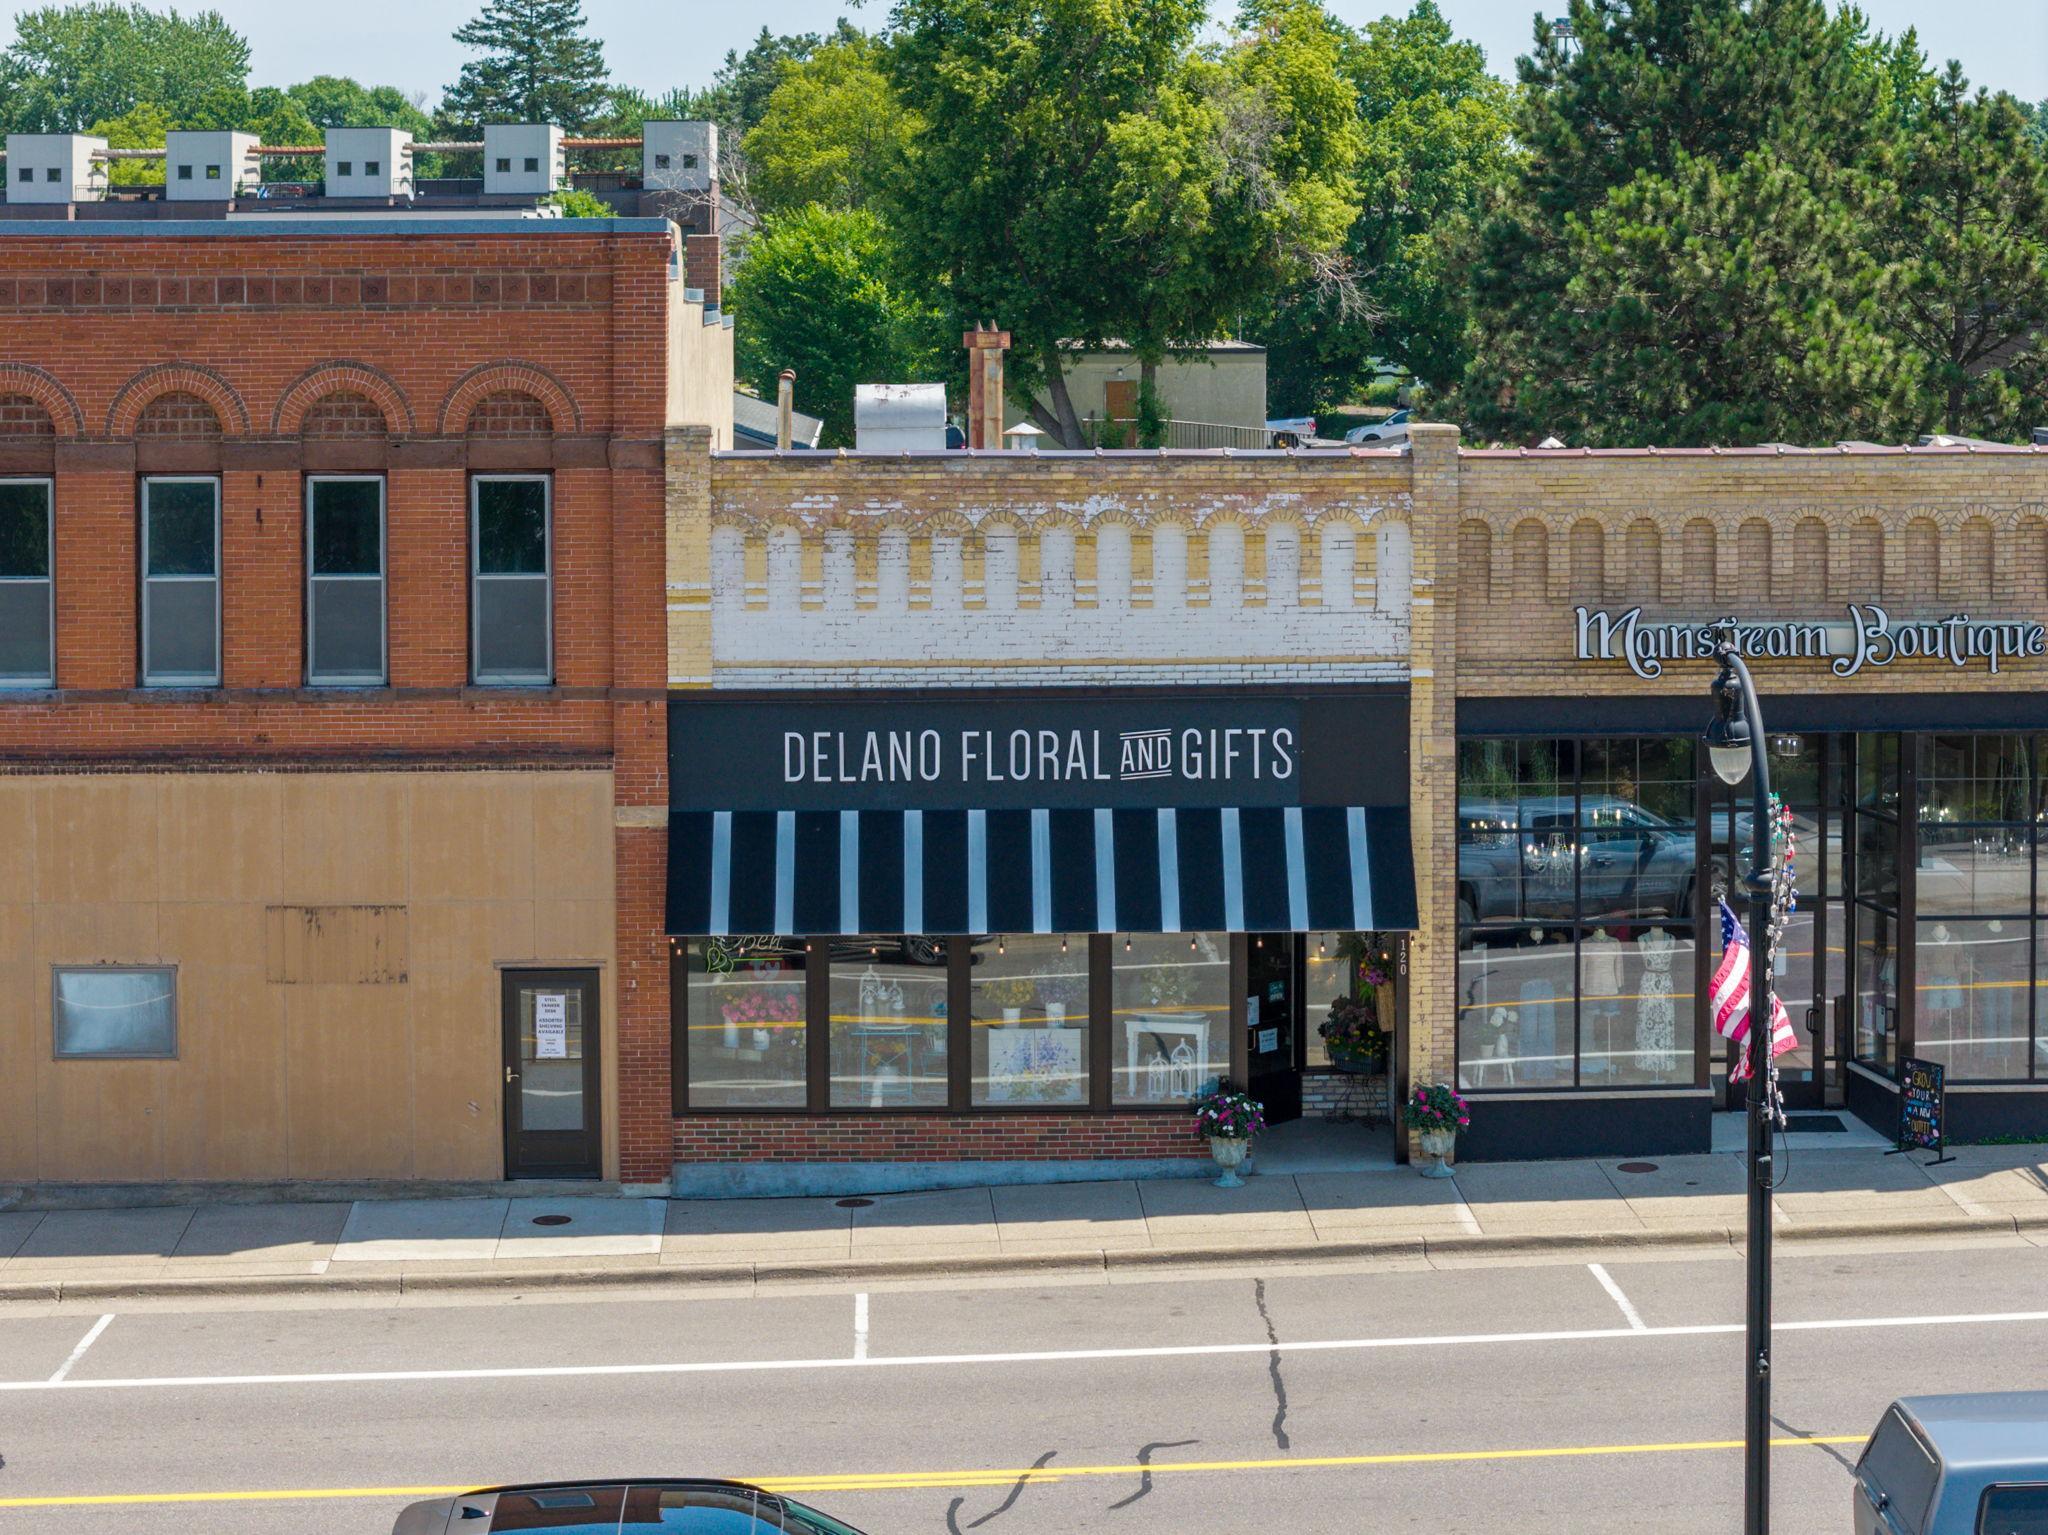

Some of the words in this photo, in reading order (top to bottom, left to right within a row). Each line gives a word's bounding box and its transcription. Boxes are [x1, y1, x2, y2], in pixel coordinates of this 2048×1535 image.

[1575, 606, 1830, 679] Mainstream
[1832, 603, 2047, 677] Boutique
[784, 729, 941, 782] DELANO
[962, 729, 1111, 781] FLORAL
[1120, 735, 1172, 773] AND
[1181, 728, 1293, 780] GIFTS
[1912, 1087, 1930, 1100] YOUR
[1913, 1106, 1919, 1115] A
[1919, 1107, 1931, 1118] NEW
